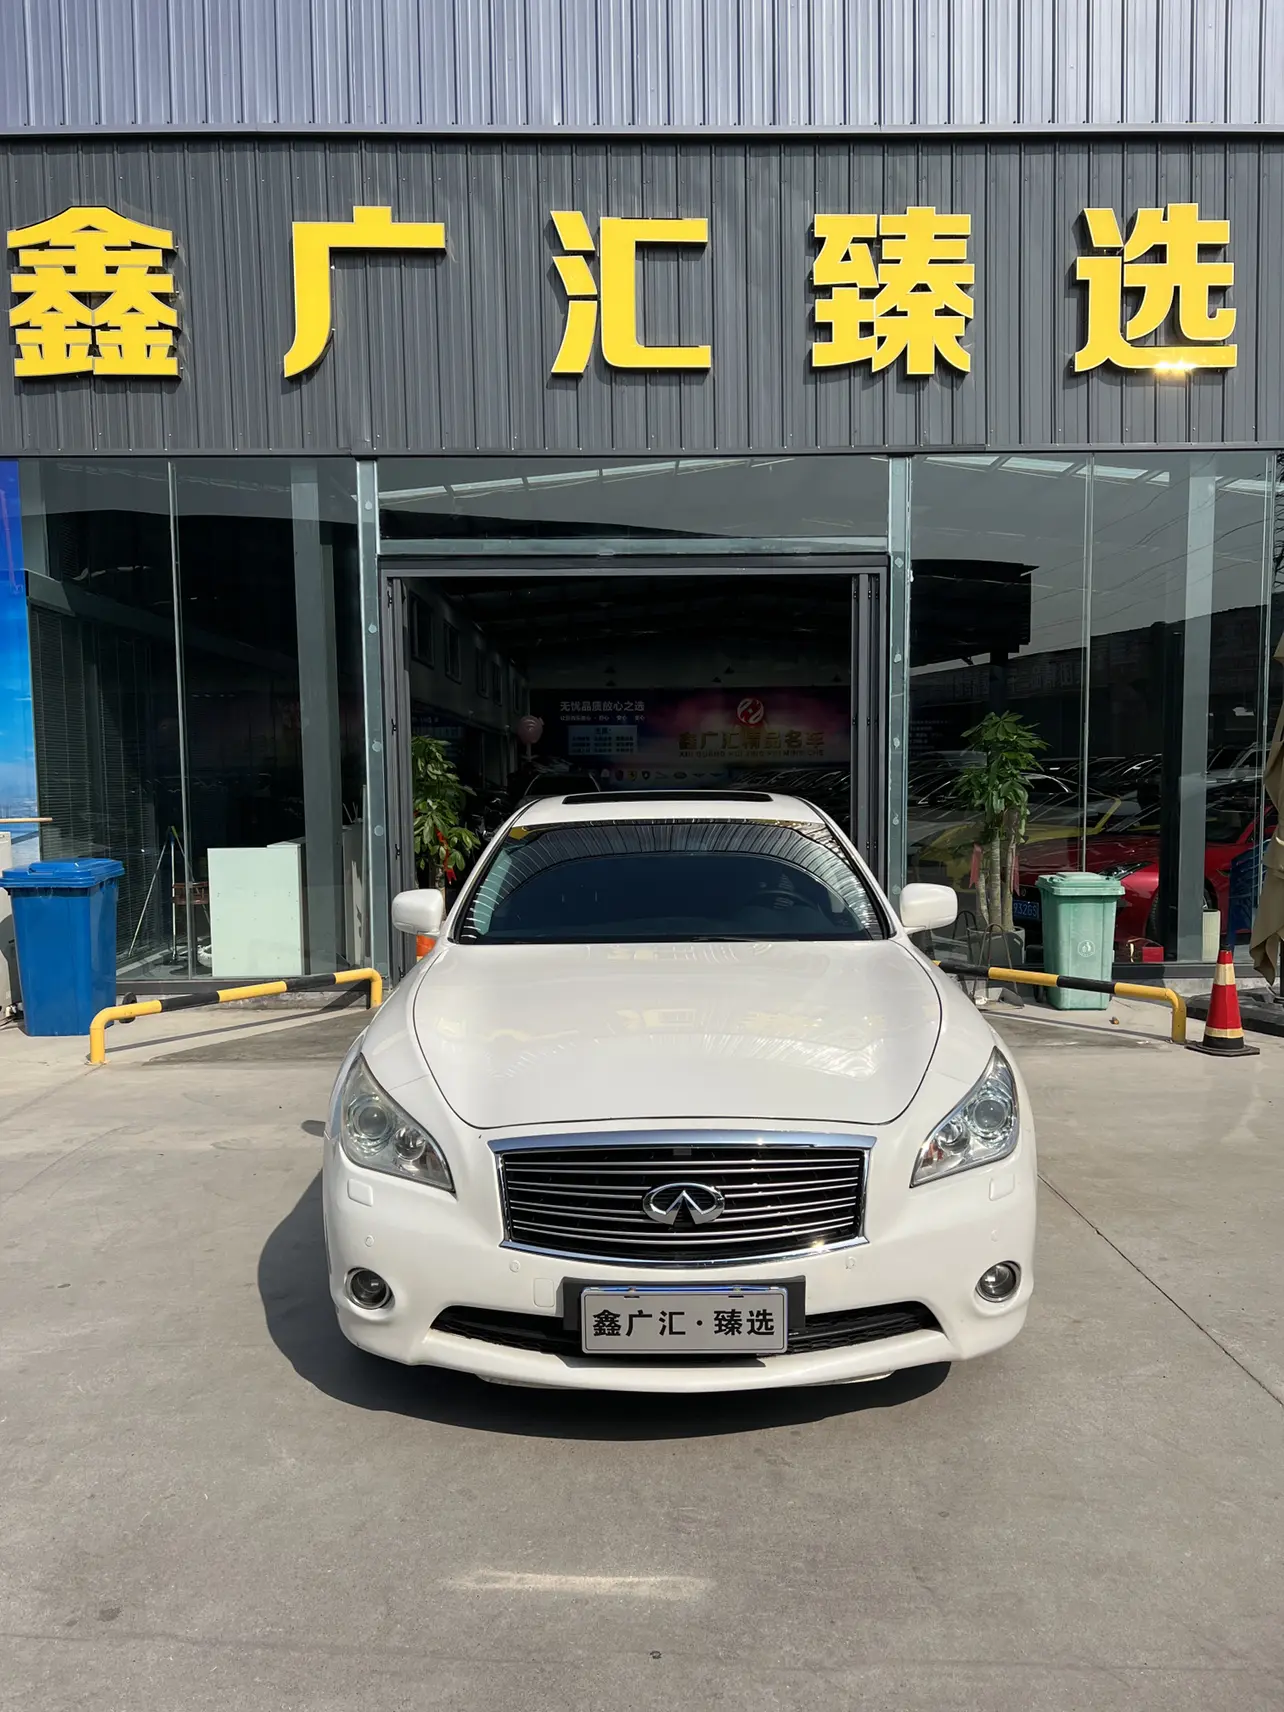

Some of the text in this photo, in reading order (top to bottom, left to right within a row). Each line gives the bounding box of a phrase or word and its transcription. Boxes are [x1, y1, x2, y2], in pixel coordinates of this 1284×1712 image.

[7, 203, 1239, 379] 鑫广汇臻选
[559, 700, 646, 712] 无忧品质放心之选
[678, 731, 825, 750] 鑫广汇精品名车
[592, 1308, 775, 1337] 鑫广汇·臻选
